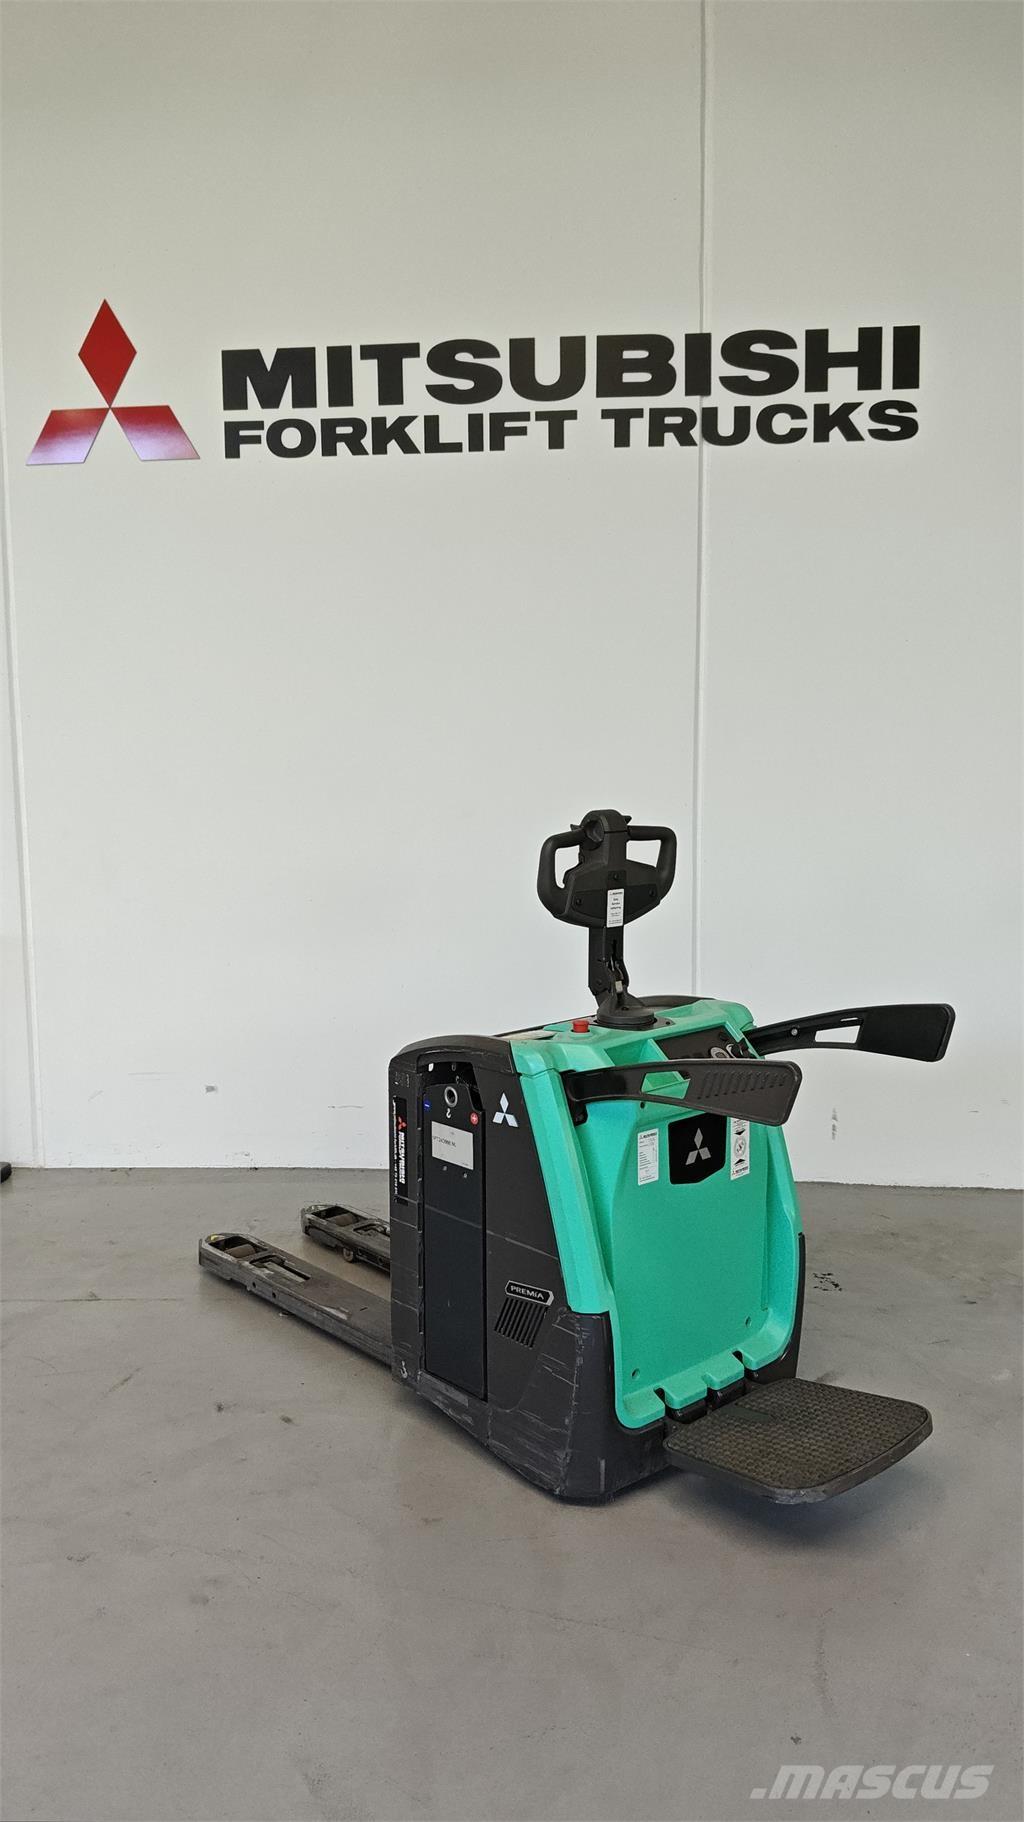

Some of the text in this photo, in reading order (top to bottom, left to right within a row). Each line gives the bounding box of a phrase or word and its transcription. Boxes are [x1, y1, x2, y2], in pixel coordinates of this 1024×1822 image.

[221, 325, 921, 411] MITSUBISHI
[224, 399, 920, 459] FORKLIFT TRUCKS
